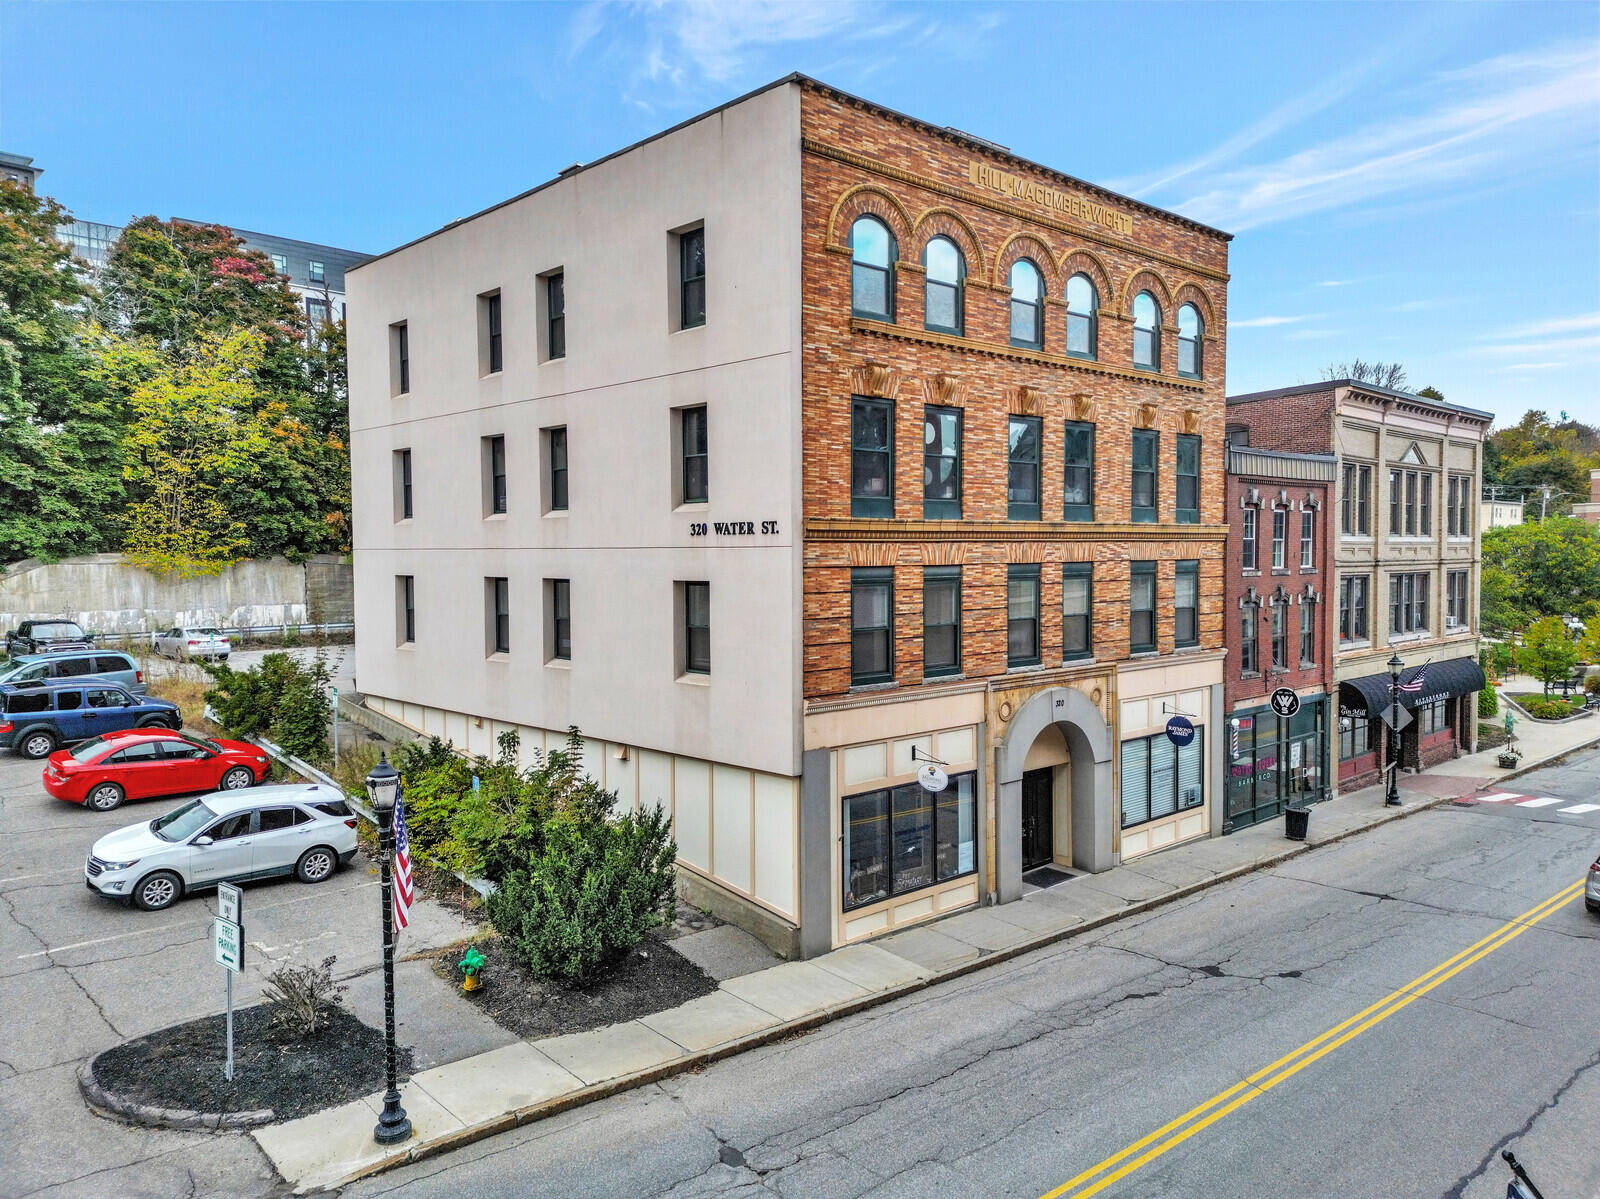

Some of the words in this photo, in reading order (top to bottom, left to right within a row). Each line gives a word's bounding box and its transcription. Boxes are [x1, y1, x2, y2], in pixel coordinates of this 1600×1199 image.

[978, 166, 1006, 193] HILL
[690, 523, 708, 536] 320
[713, 521, 755, 535] WATER
[761, 520, 780, 534] ST.
[222, 925, 233, 941] FREE
[218, 937, 237, 956] PARKING
